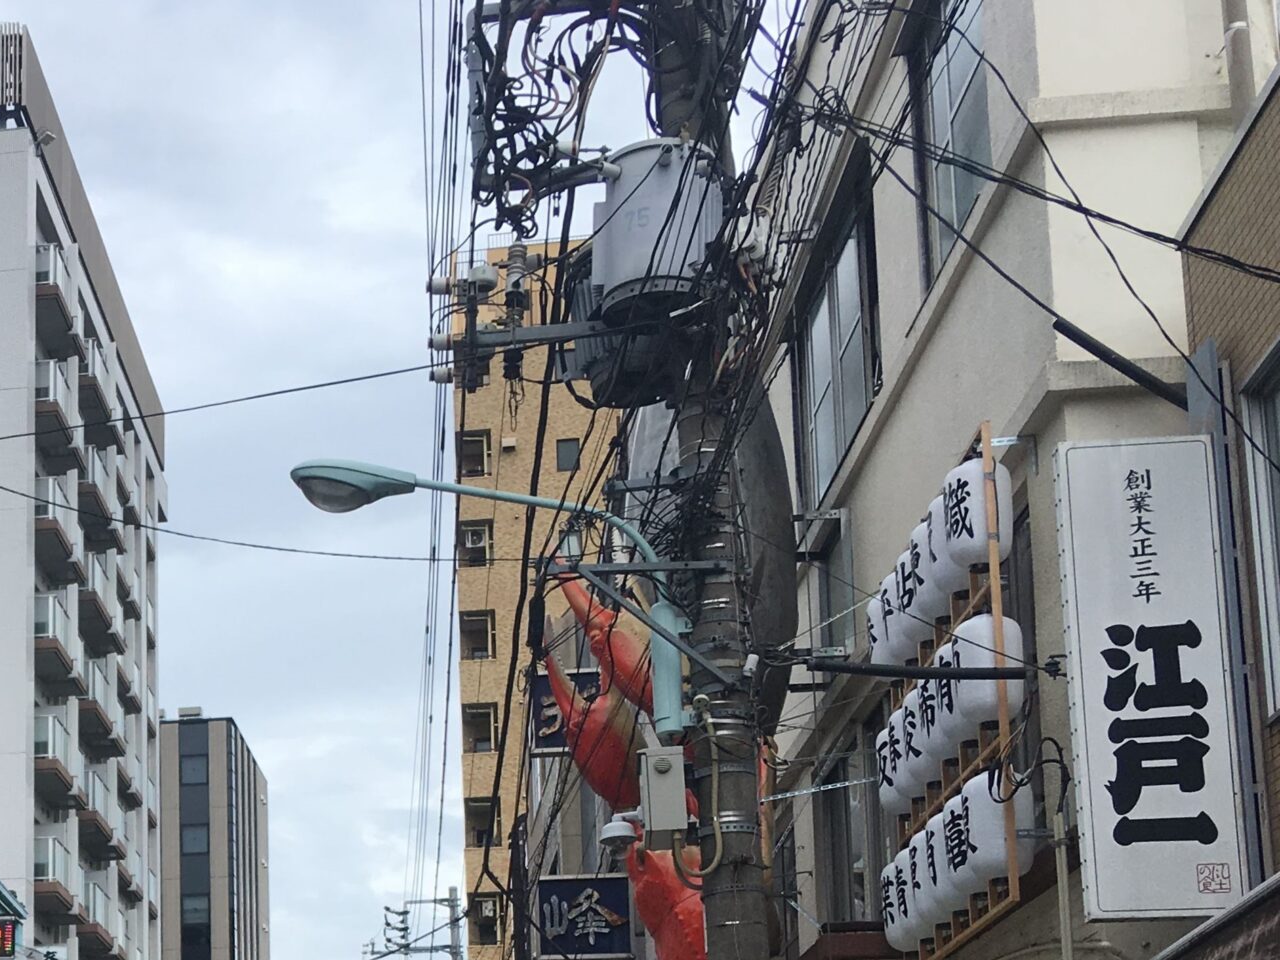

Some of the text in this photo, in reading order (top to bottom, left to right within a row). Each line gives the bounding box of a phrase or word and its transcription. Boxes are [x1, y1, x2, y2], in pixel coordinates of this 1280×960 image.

[1123, 468, 1161, 604] 創業大正三年
[1100, 618, 1219, 847] 江戸一
